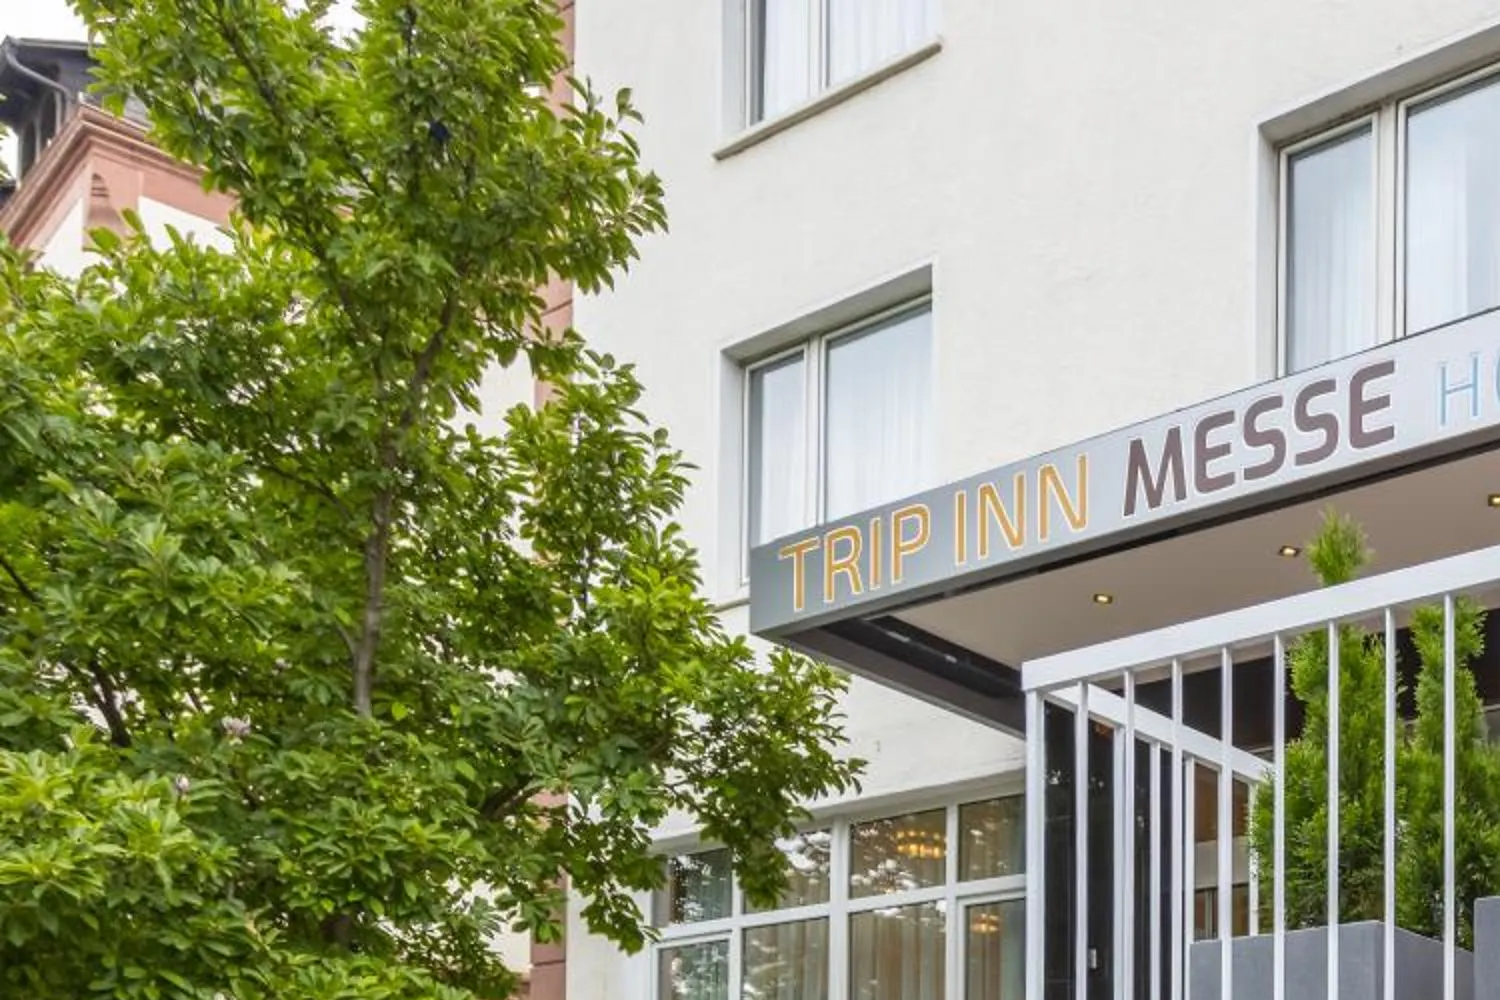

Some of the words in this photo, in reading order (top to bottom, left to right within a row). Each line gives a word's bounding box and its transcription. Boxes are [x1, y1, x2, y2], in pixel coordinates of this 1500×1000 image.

[778, 503, 932, 613] TRIP
[954, 452, 1089, 567] INN
[1122, 358, 1396, 518] MESSE
